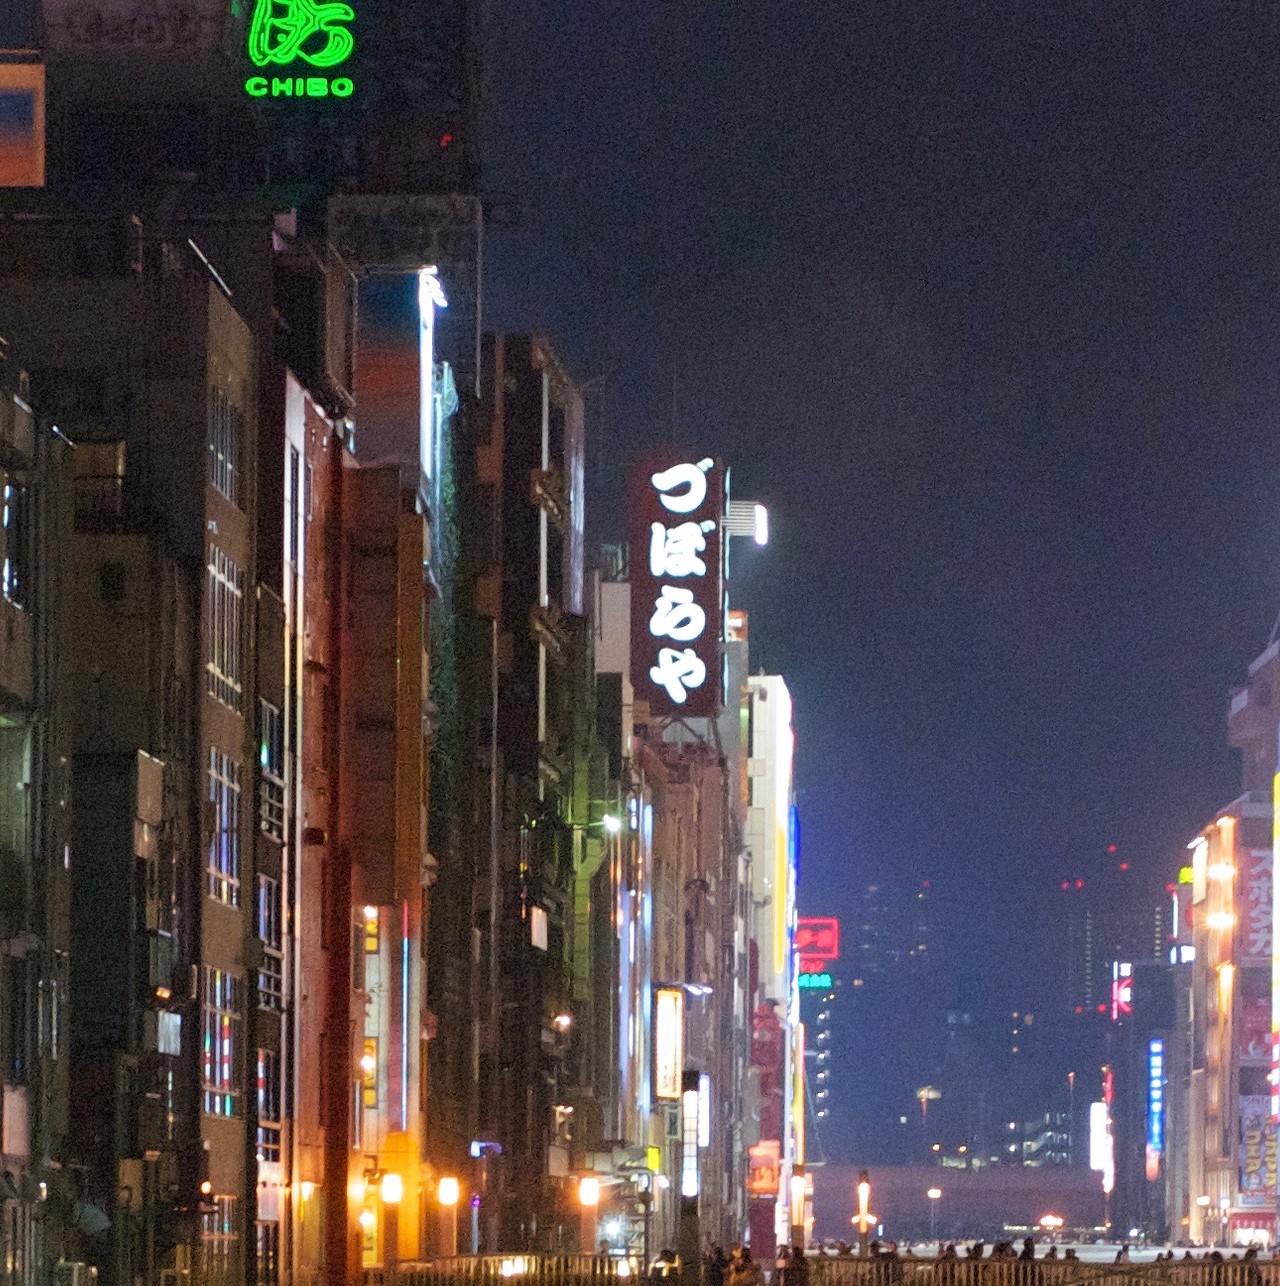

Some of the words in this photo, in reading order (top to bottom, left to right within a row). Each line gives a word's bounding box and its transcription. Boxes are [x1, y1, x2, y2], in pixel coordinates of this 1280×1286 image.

[245, 76, 354, 97] CHIBO
[649, 457, 716, 704] づぼらや
